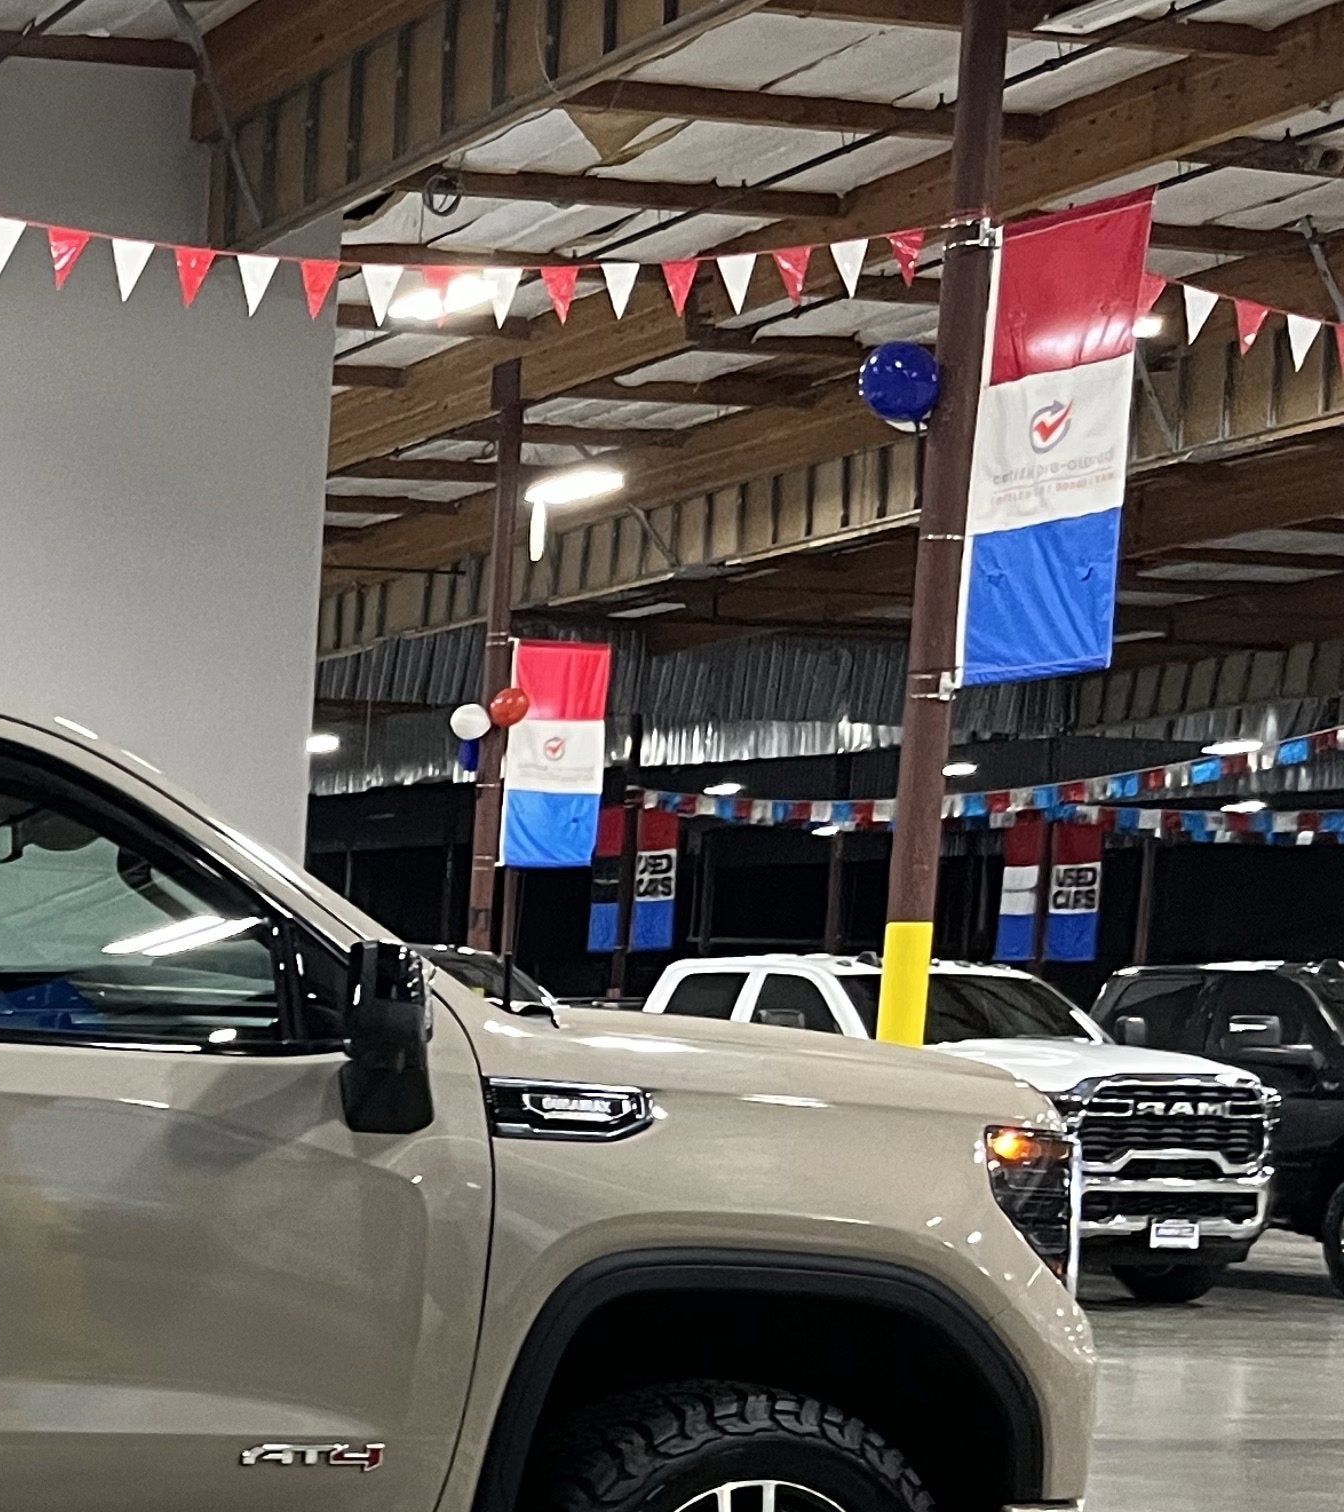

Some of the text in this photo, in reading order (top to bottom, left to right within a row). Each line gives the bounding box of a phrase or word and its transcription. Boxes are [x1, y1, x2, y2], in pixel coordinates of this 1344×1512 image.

[638, 853, 673, 875] UED
[1136, 1101, 1227, 1116] RAM
[241, 1443, 386, 1472] AT4
